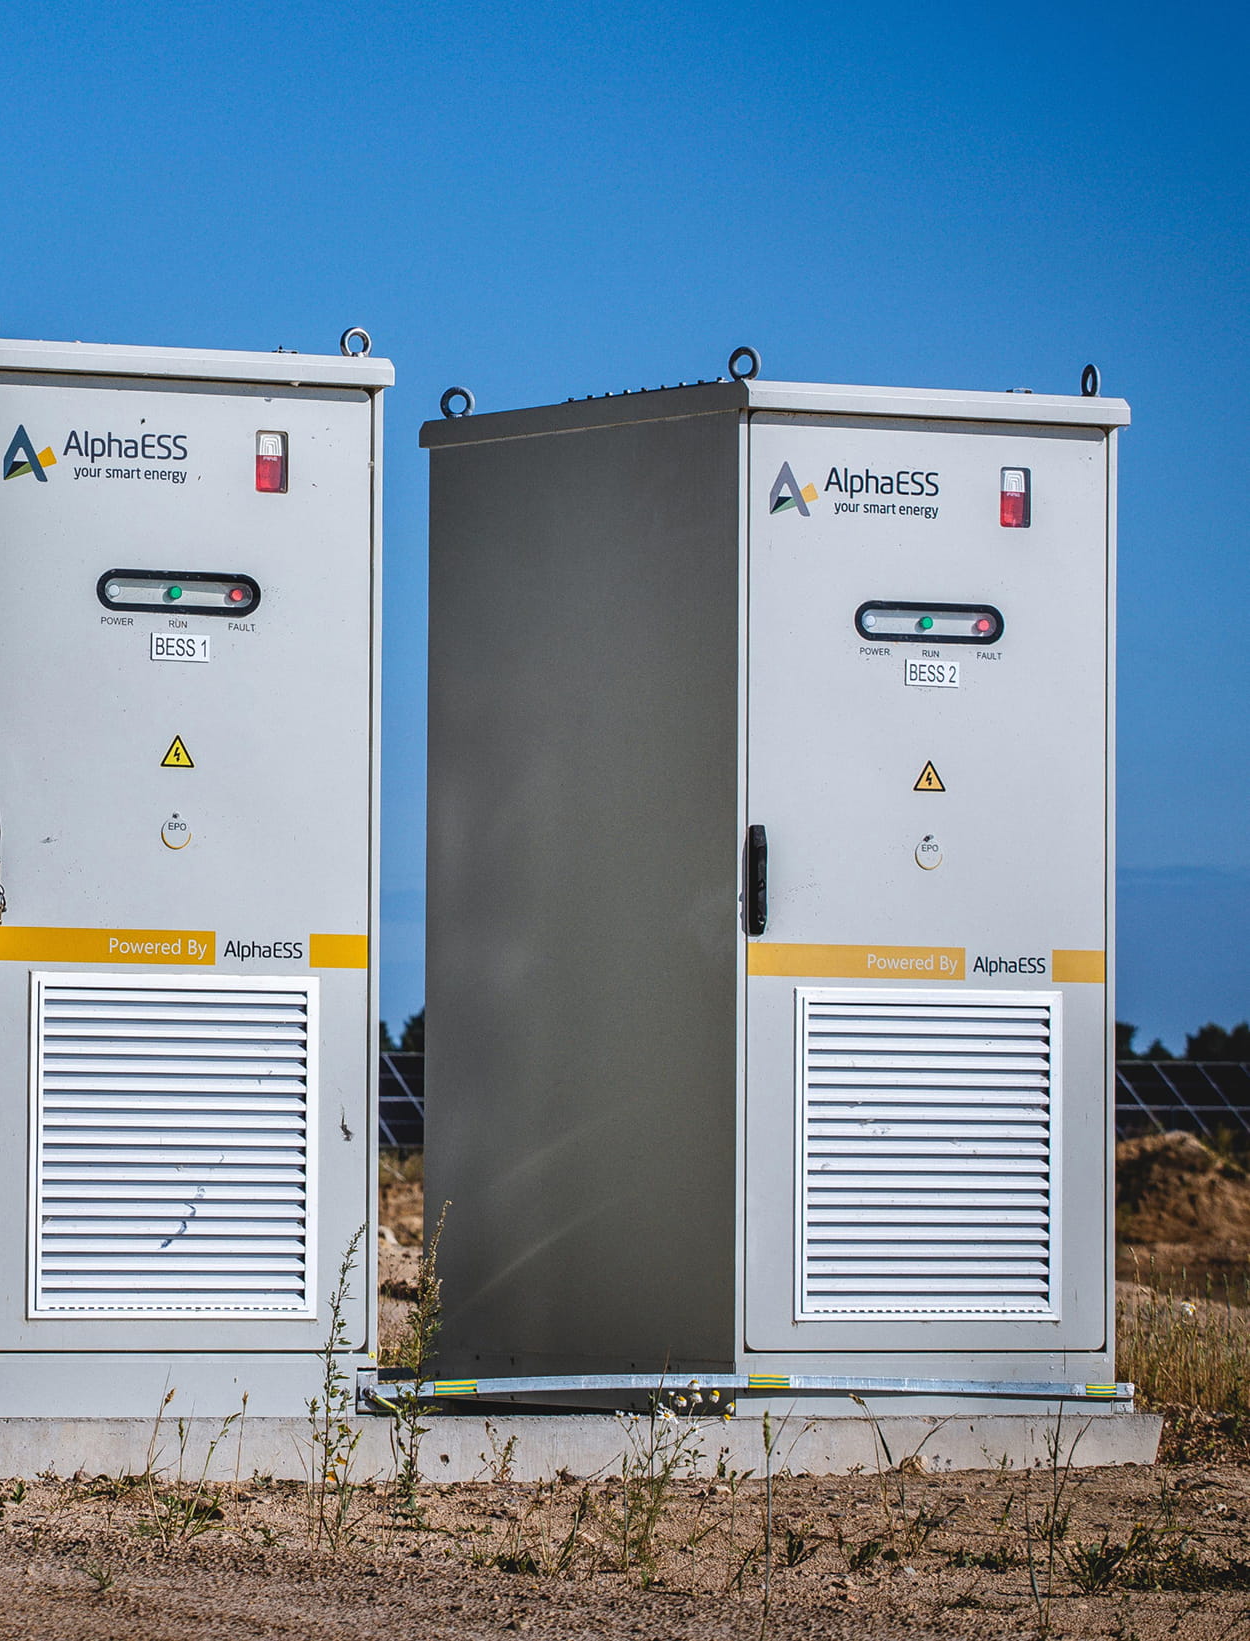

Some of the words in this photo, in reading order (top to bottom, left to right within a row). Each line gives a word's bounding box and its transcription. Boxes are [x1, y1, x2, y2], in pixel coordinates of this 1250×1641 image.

[63, 430, 187, 463] AlphaESS
[74, 467, 102, 480] your
[106, 468, 141, 479] smart
[144, 470, 187, 484] energy
[824, 467, 939, 499] AlphaESS
[834, 503, 860, 514] your
[863, 504, 896, 514] smart
[899, 506, 938, 519] energy
[101, 617, 133, 626] POWER
[169, 619, 187, 628] RUN
[228, 622, 255, 632] FAULT
[156, 637, 195, 657] BESS
[200, 640, 207, 658] 1
[859, 647, 890, 656] POWER
[922, 650, 939, 658] RUN
[977, 652, 1002, 660] FAULT
[909, 664, 945, 683] BESS
[949, 666, 956, 683] 2
[168, 822, 187, 831] EPO
[921, 844, 939, 852] EPO
[108, 937, 181, 955] Powered
[188, 939, 207, 960] By
[224, 940, 303, 961] AlphaESS
[868, 954, 933, 970] Powered
[940, 956, 957, 974] By
[973, 956, 1046, 976] AlphaESS
